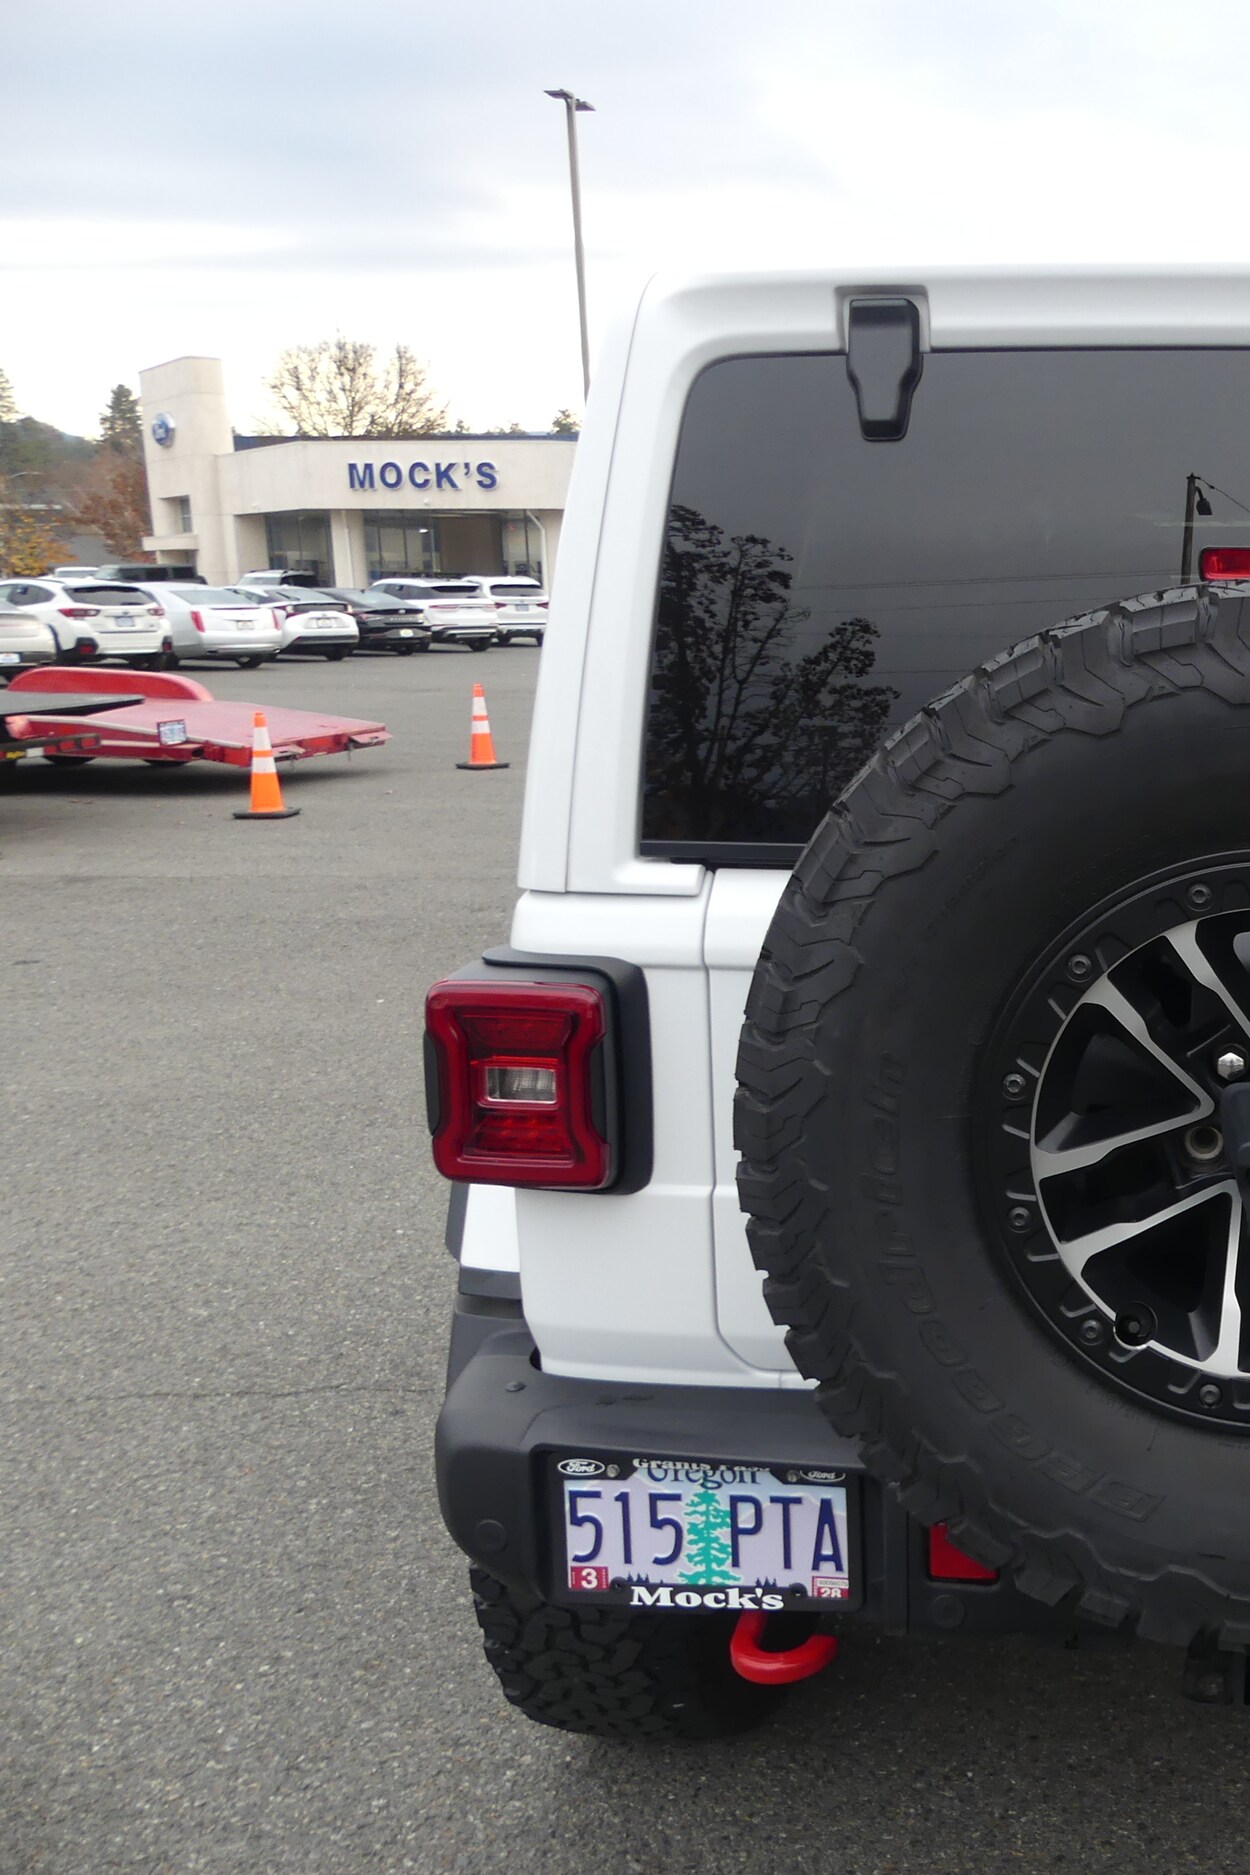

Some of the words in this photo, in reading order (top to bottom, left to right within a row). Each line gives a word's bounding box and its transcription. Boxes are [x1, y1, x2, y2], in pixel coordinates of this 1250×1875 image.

[347, 461, 498, 490] MOCK'S
[566, 1460, 596, 1472] Ford
[568, 1490, 683, 1566] 515
[729, 1495, 844, 1571] PTA
[581, 1568, 598, 1589] 3
[630, 1585, 785, 1610] Mock's
